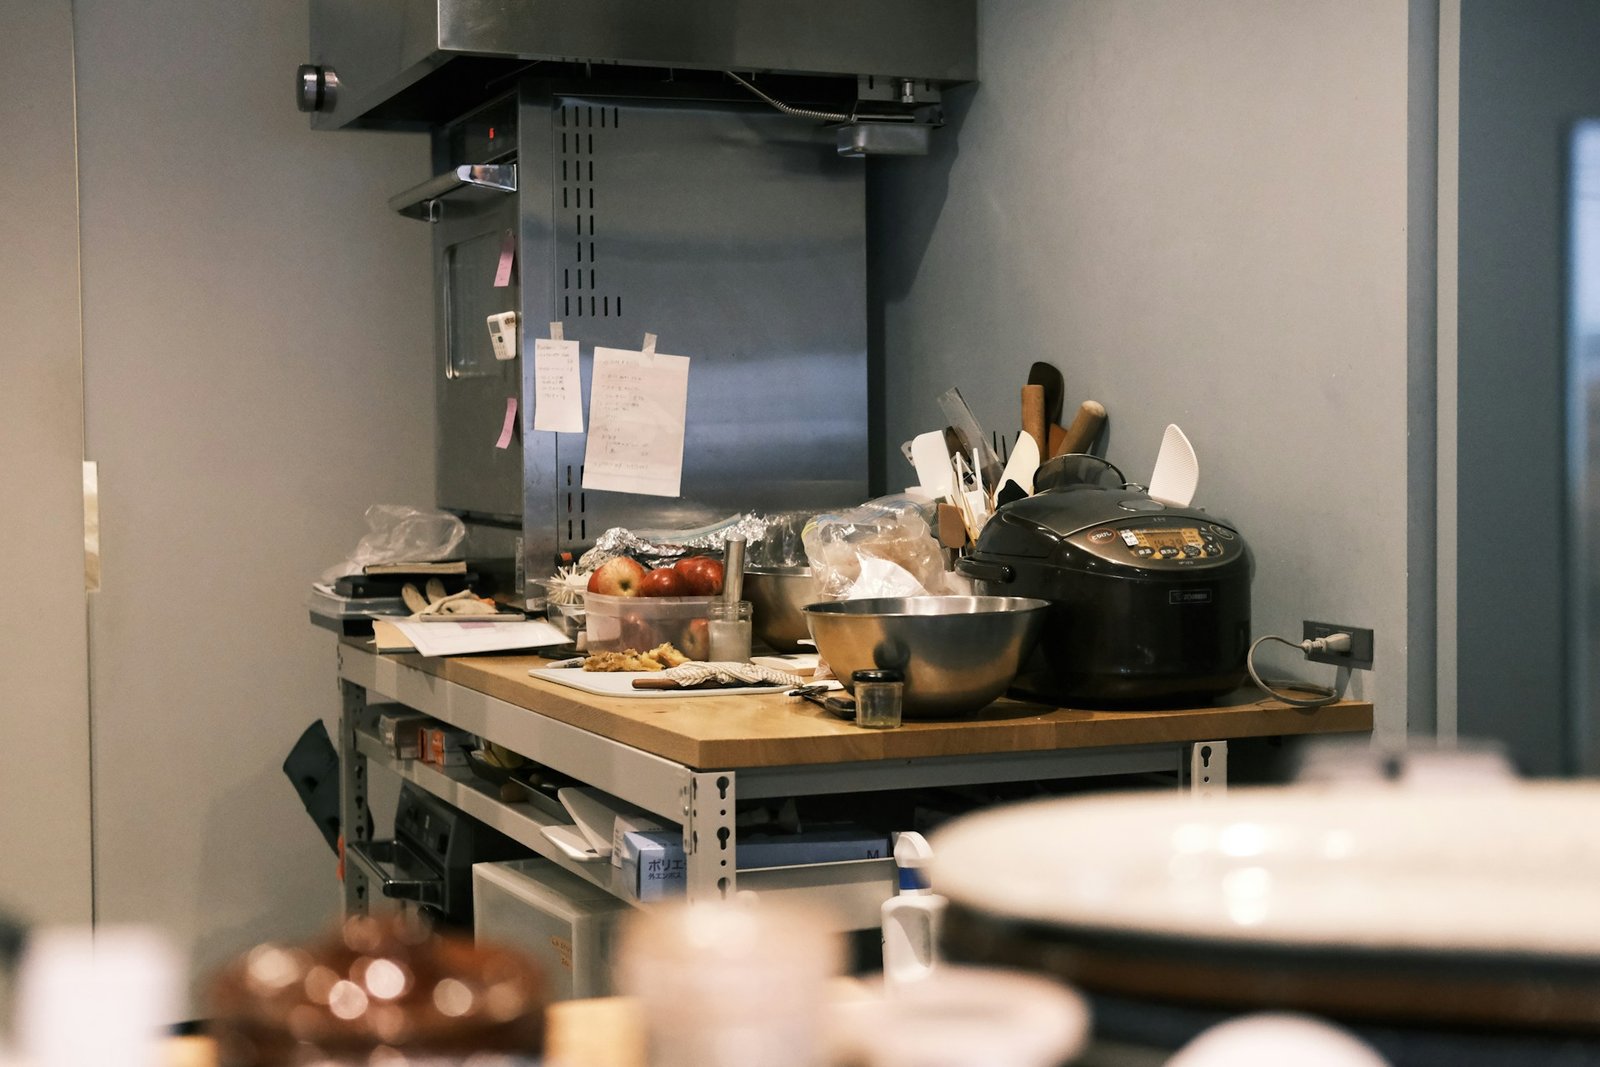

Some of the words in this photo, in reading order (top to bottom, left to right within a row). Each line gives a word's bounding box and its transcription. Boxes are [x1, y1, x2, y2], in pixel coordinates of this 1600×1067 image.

[867, 850, 879, 859] M
[648, 859, 687, 872] ポリエ
